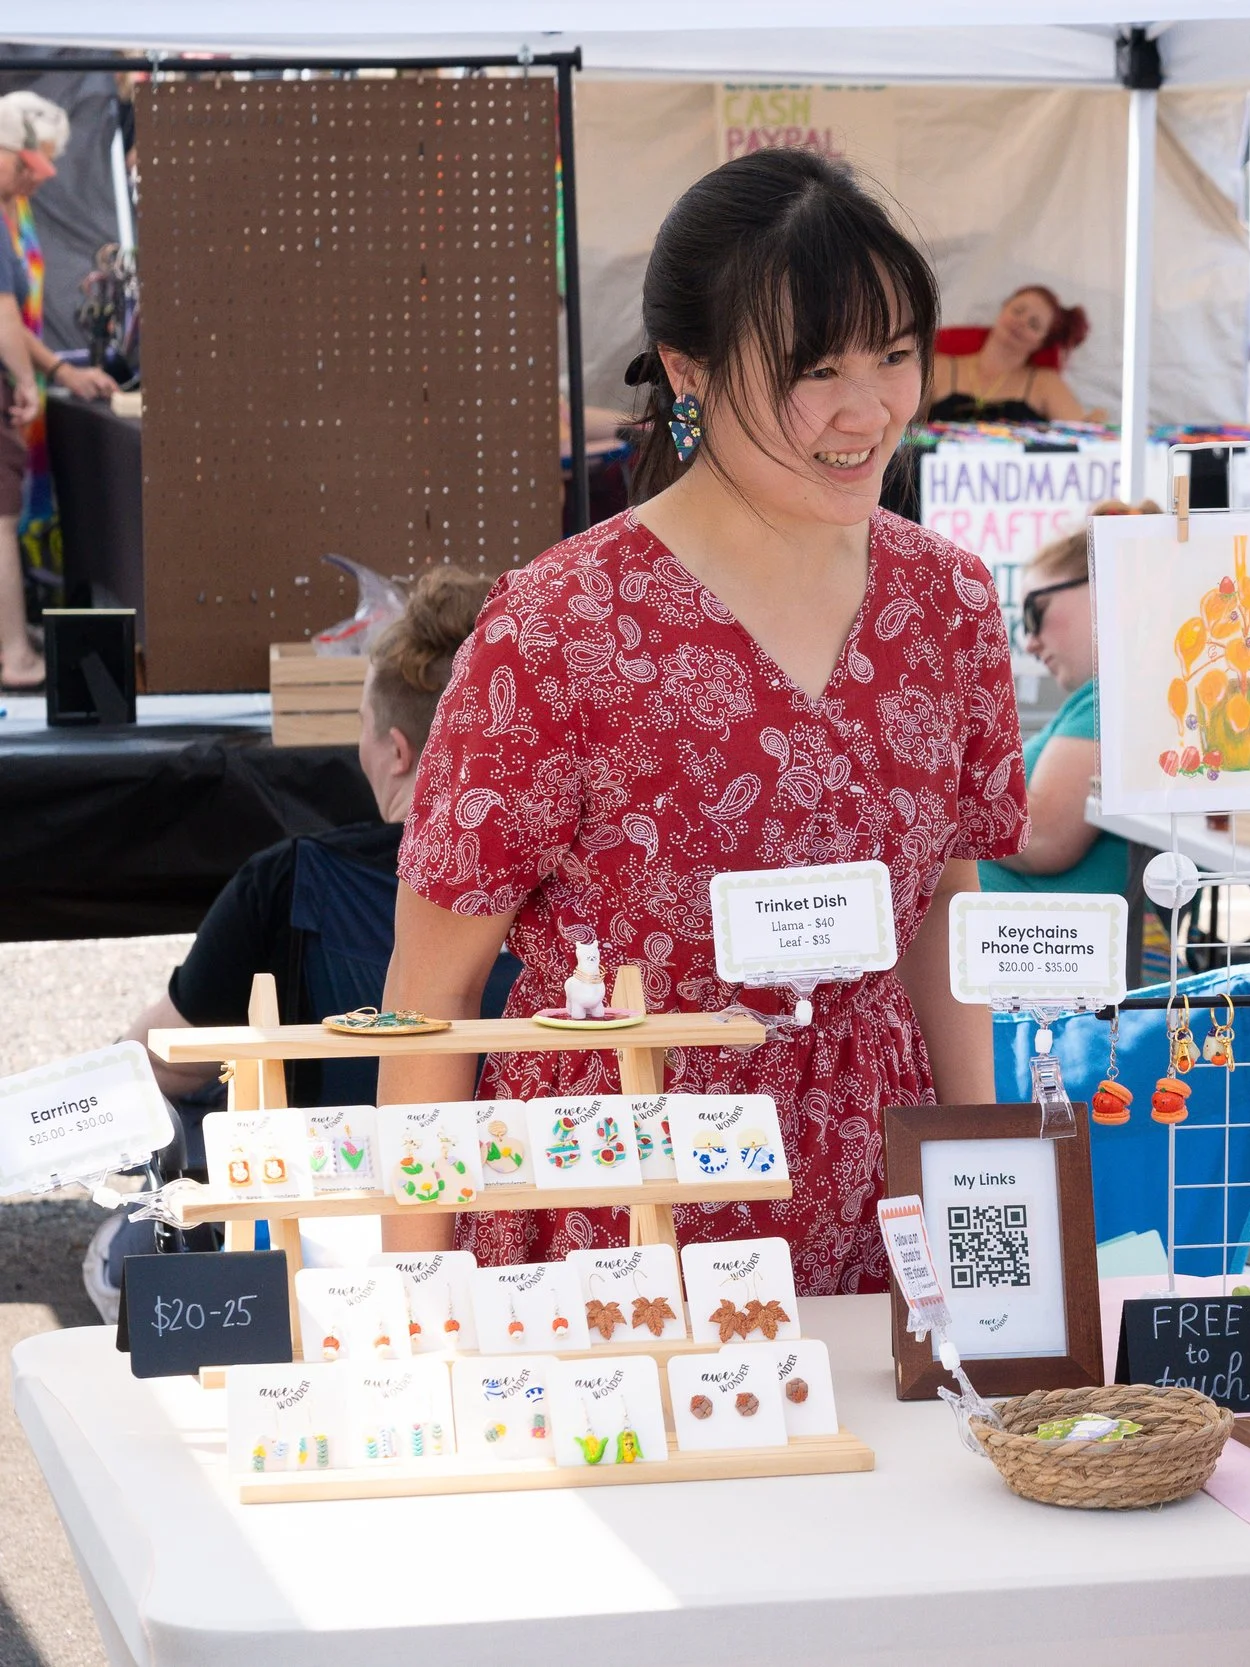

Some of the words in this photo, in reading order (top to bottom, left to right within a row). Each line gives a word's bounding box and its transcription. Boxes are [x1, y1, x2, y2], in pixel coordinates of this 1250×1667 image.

[723, 91, 812, 126] CASH
[930, 461, 1121, 503] HANDMADE
[755, 897, 810, 913] Trinket
[813, 894, 847, 909] Dish
[772, 920, 804, 932] Llama
[815, 917, 835, 929] $40
[998, 925, 1078, 942] Keychains
[779, 936, 802, 948] Leaf
[812, 934, 831, 946] $35
[981, 941, 1029, 954] Phone
[1033, 941, 1095, 955] Charms
[998, 961, 1034, 972] $20.00
[1045, 962, 1079, 973] $35.00
[30, 1096, 98, 1124] Earrings
[554, 1106, 583, 1117] awe
[572, 1100, 602, 1126] WONDER
[631, 1101, 650, 1111] we
[638, 1096, 668, 1121] WONDER
[699, 1111, 727, 1121] awe
[323, 1111, 344, 1130] WONDER
[419, 1108, 440, 1128] WONDER
[716, 1105, 744, 1131] WONDER
[29, 1126, 66, 1146] $25.00
[76, 1111, 114, 1131] $30.00
[954, 1174, 975, 1189] My
[979, 1173, 1016, 1186] Links
[395, 1261, 424, 1273] awe
[412, 1254, 444, 1284] WONDER
[595, 1258, 624, 1269] awe
[612, 1251, 643, 1280] WONDER
[713, 1259, 741, 1271] awe
[730, 1252, 761, 1280] WONDER
[498, 1273, 527, 1284] awe
[516, 1265, 546, 1293] WONDER
[151, 1295, 258, 1337] $20-25
[1153, 1303, 1243, 1340] FREE
[1185, 1343, 1210, 1364] to
[501, 1368, 531, 1400] WONDER
[575, 1378, 606, 1389] awe
[592, 1369, 624, 1400] WONDER
[701, 1371, 731, 1382] awe
[719, 1363, 750, 1393] WONDER
[1155, 1351, 1250, 1400] touch
[259, 1387, 289, 1398] awe
[276, 1379, 311, 1410] WONDER
